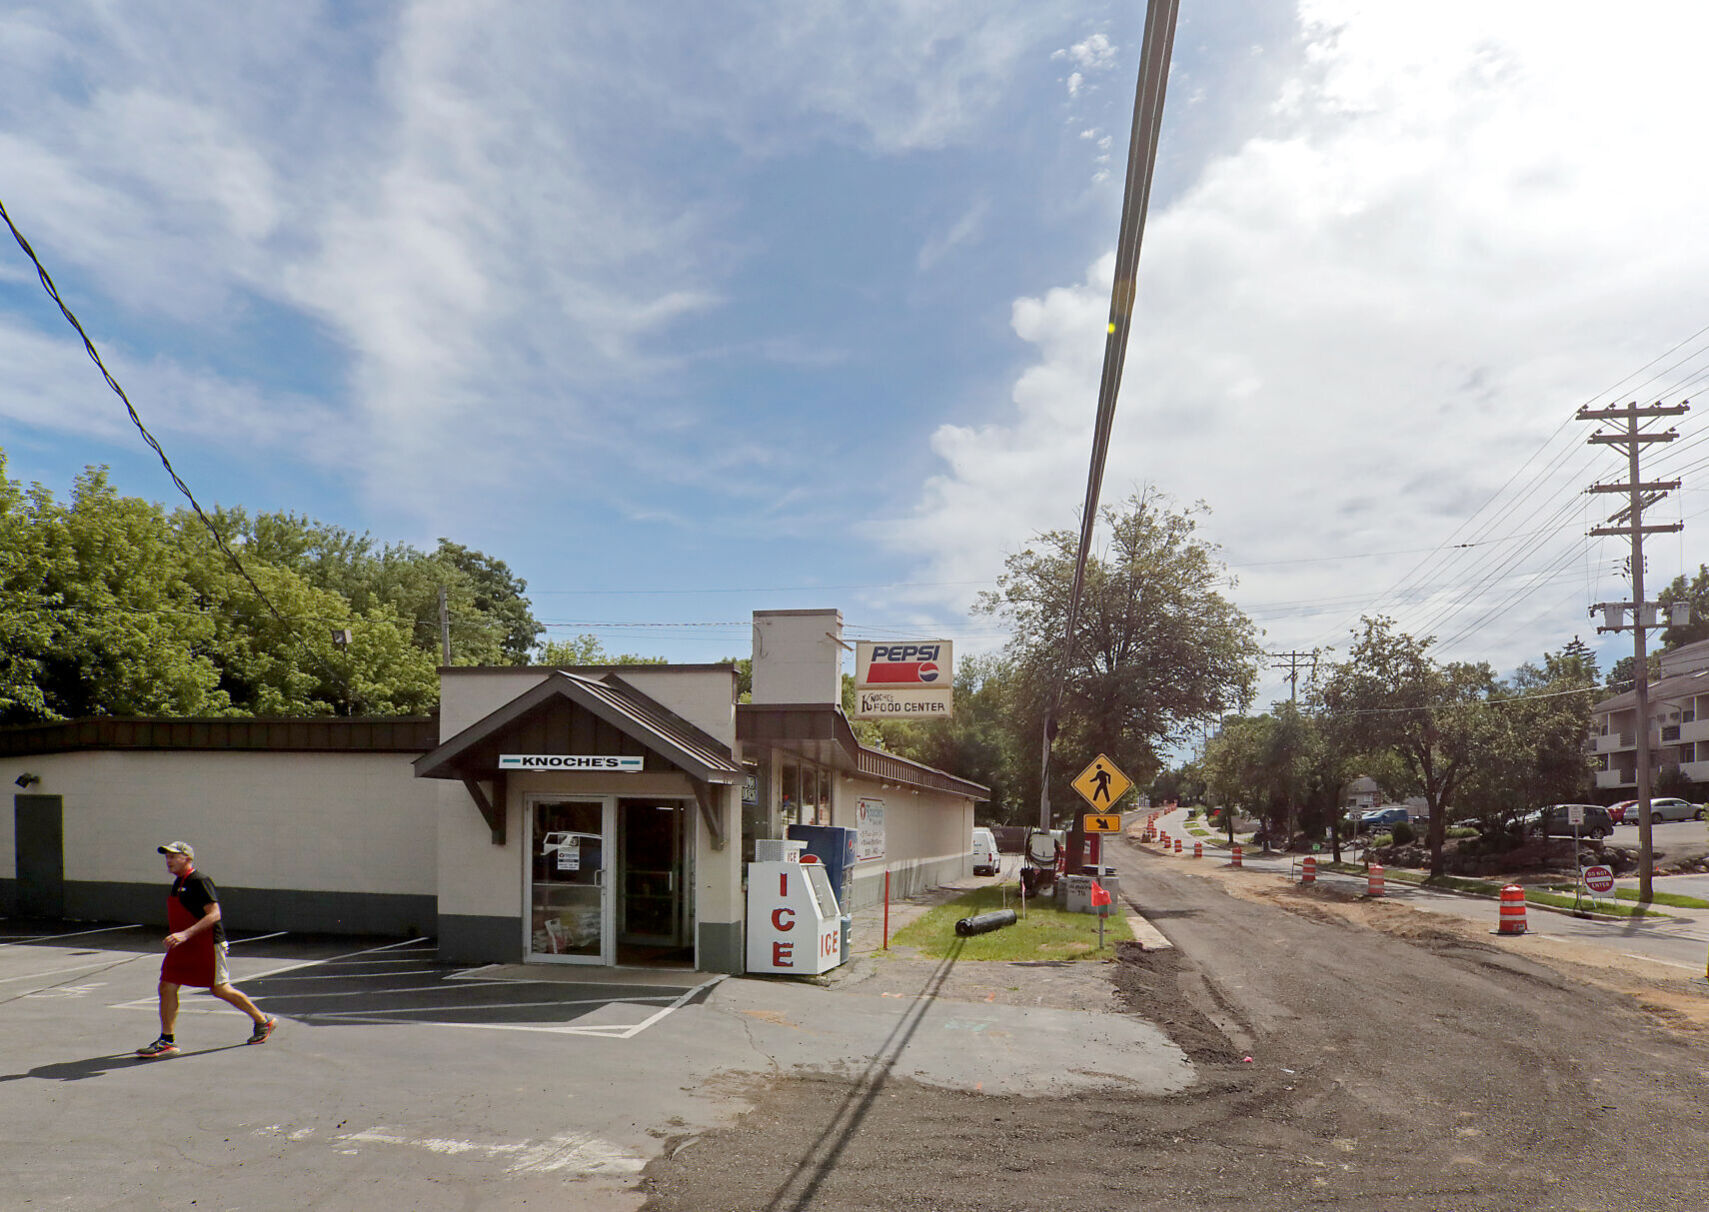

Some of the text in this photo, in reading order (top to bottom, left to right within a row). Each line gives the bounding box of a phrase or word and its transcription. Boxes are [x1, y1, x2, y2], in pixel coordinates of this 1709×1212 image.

[871, 645, 941, 662] PEPSI
[874, 702, 945, 712] FOOD CENTER
[522, 757, 619, 767] KNOCHE'S
[771, 873, 796, 968] ICE
[820, 931, 838, 958] ICE
